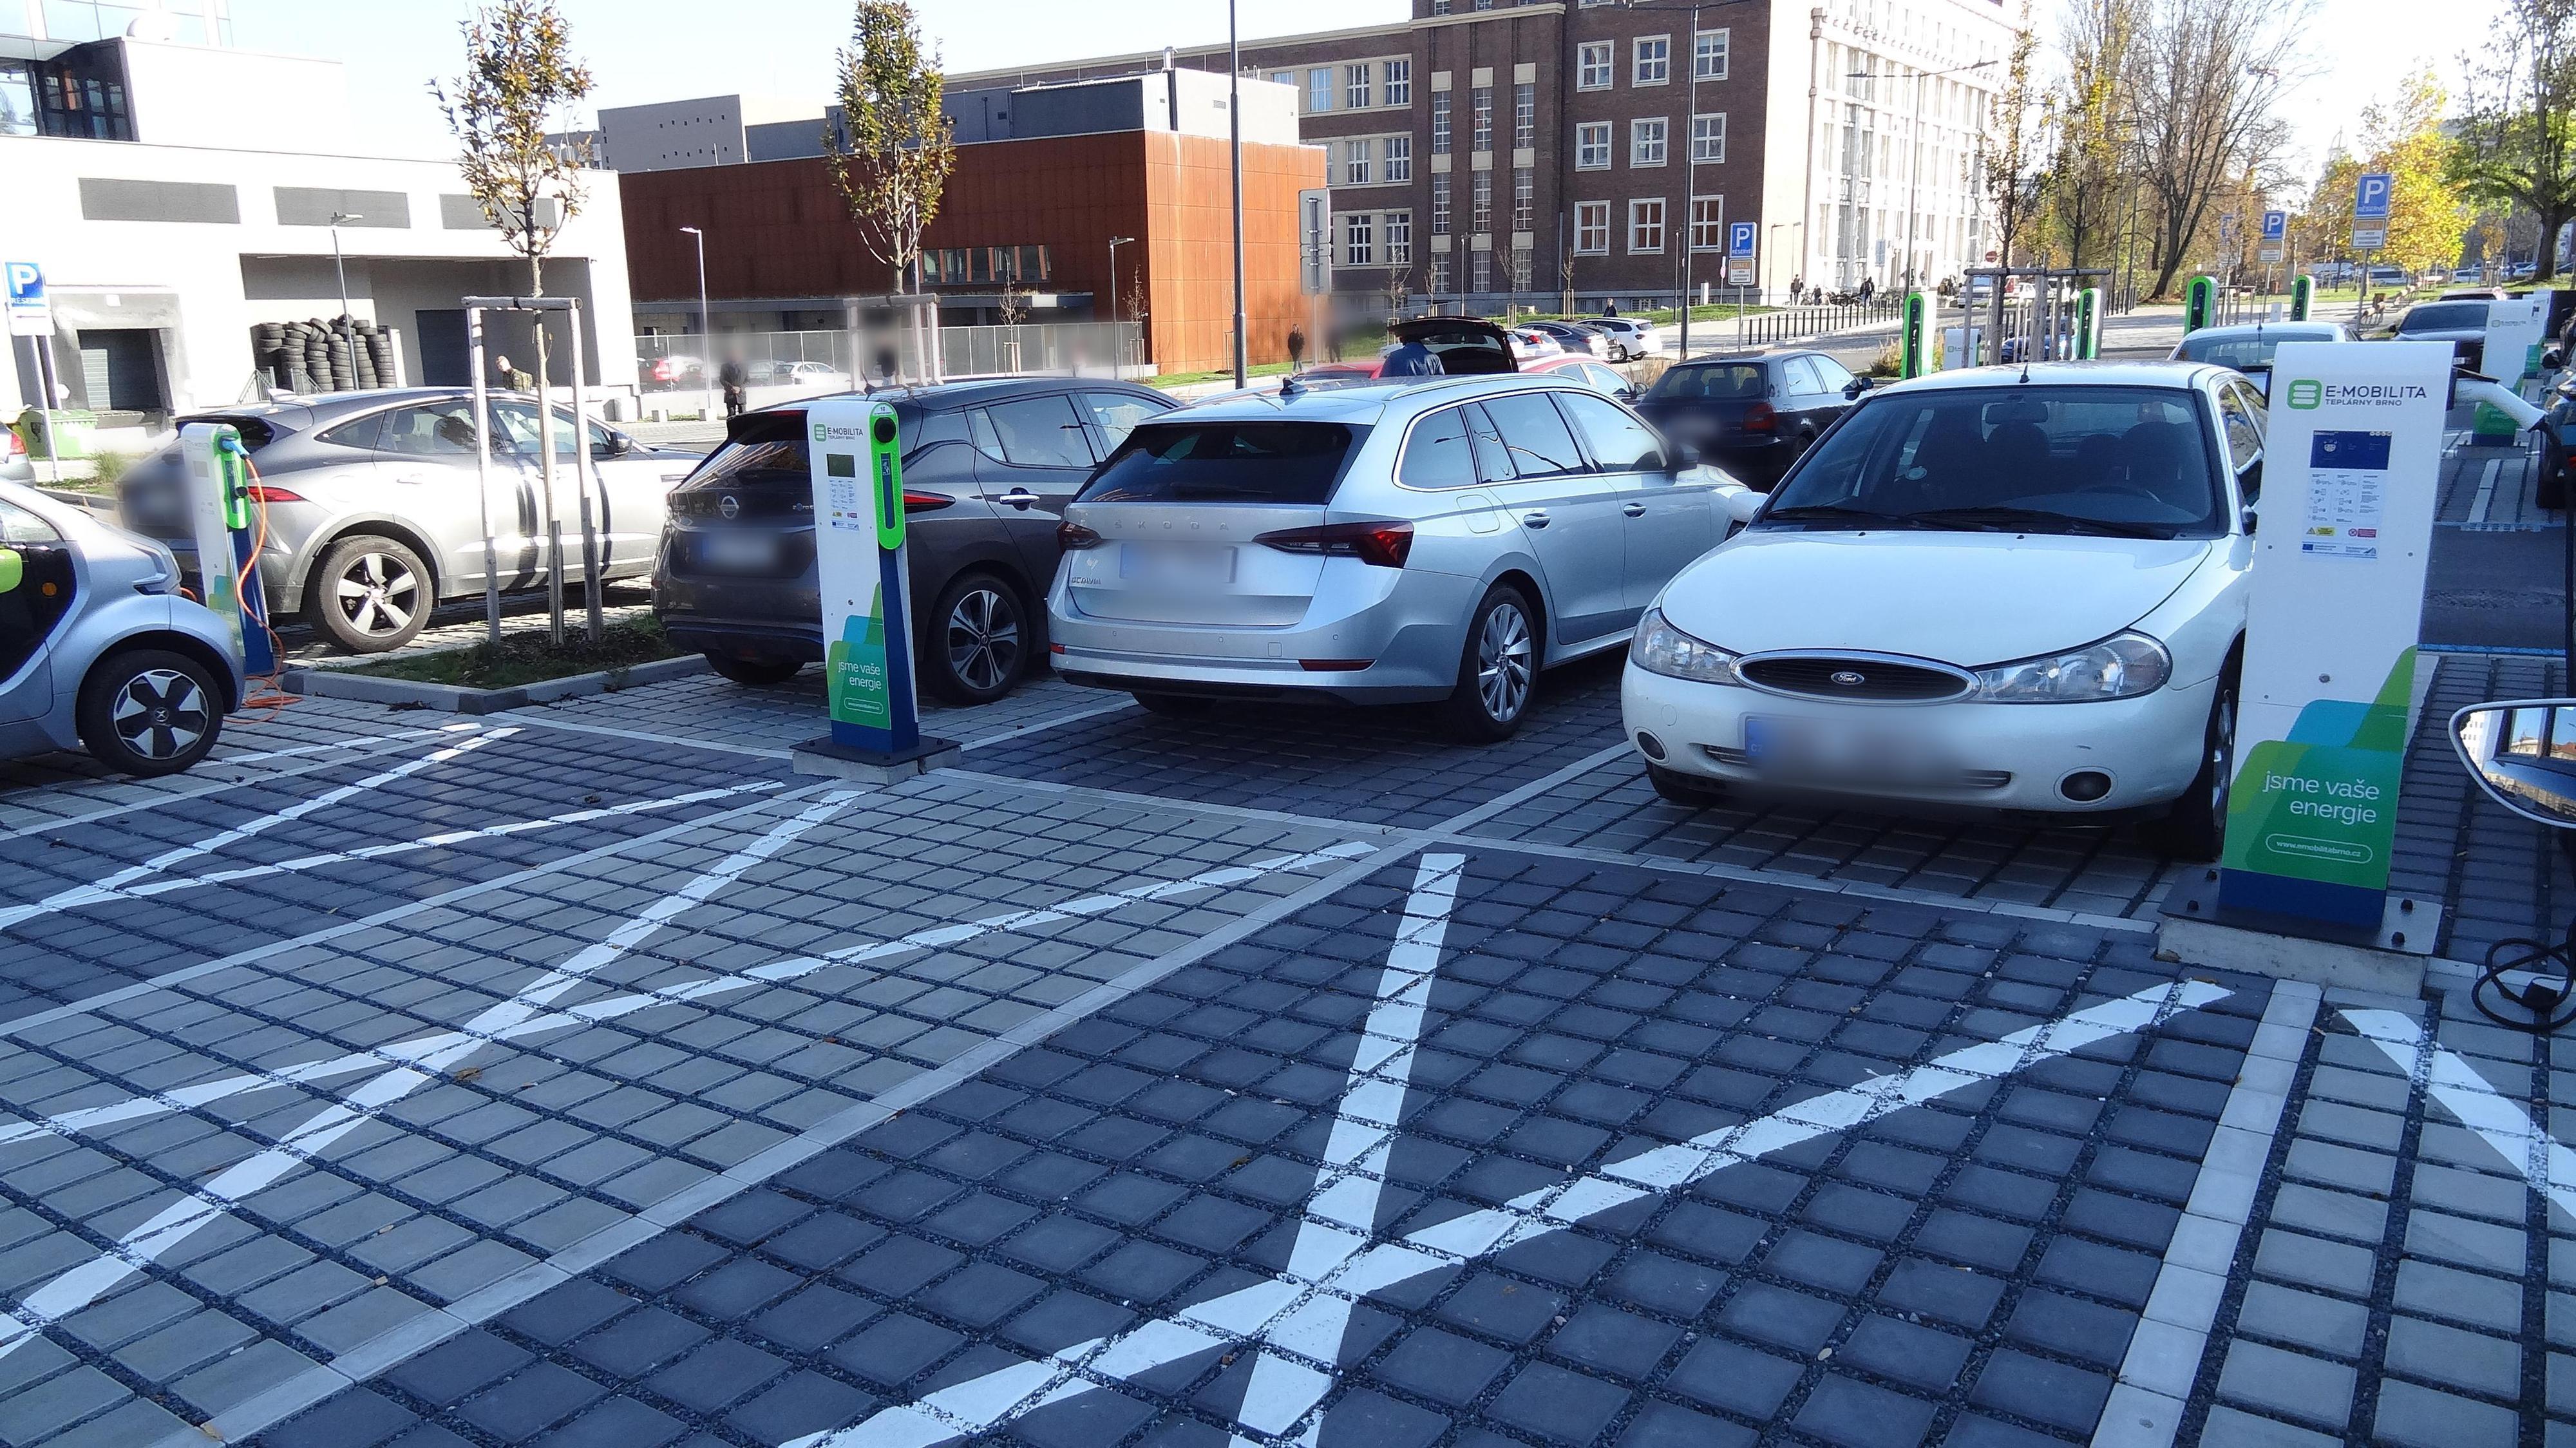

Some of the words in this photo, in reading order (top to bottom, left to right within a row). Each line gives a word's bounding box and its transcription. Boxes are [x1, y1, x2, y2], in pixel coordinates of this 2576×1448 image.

[2364, 180, 2385, 204] P
[2268, 215, 2282, 232] P
[1736, 227, 1750, 247] P
[12, 265, 37, 294] P
[2325, 385, 2427, 398] E-MOBILITA
[827, 427, 864, 436] E-MOBILITA
[838, 660, 859, 673] jsme
[860, 663, 881, 676] vaše
[849, 676, 882, 691] energie
[1837, 673, 1857, 683] Ford
[2262, 770, 2319, 793] jsme
[2325, 779, 2380, 800] vaše
[2289, 799, 2378, 825] energie
